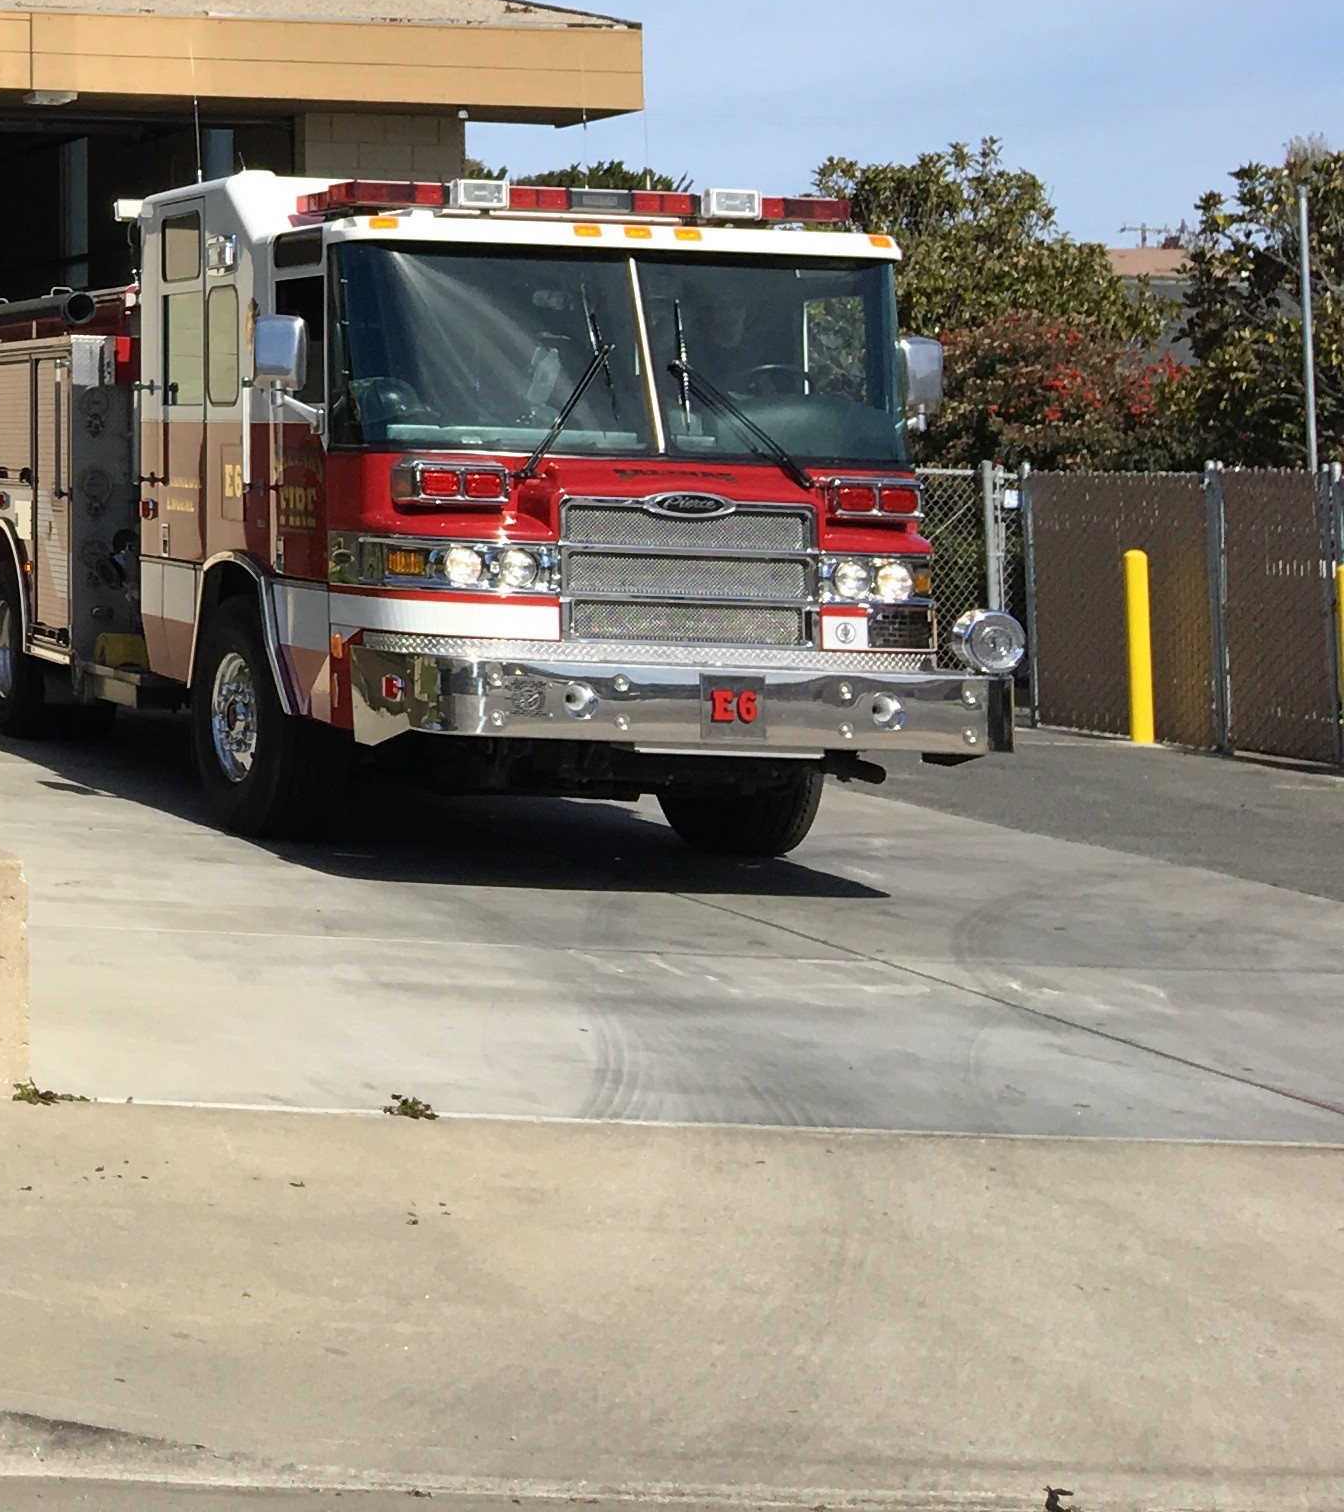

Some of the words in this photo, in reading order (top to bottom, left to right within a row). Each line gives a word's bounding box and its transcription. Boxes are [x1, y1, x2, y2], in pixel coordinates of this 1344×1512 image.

[224, 464, 243, 499] E6
[662, 495, 718, 511] Pierce
[711, 689, 759, 724] E6
